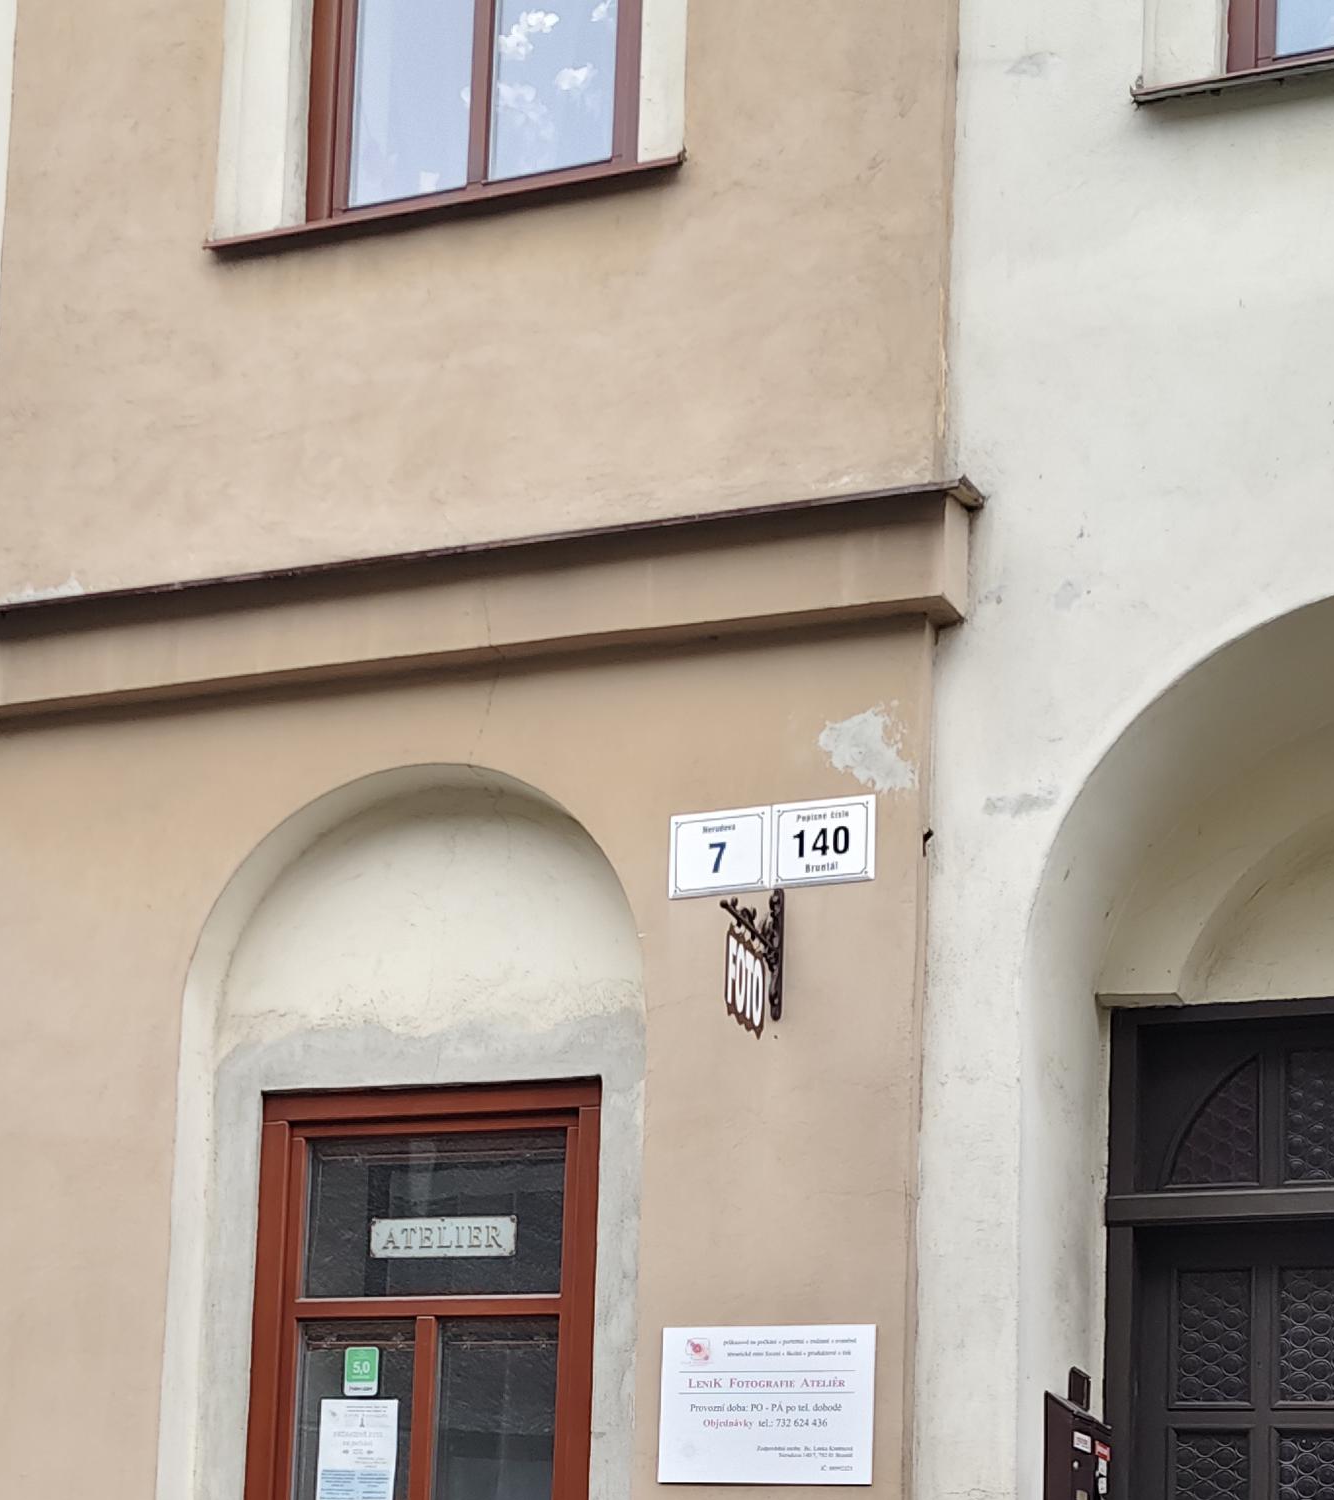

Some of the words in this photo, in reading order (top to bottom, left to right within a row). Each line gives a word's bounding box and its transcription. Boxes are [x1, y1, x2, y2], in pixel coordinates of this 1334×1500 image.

[793, 825, 850, 858] 140
[709, 841, 727, 873] 7
[805, 861, 838, 873] Bruntál
[727, 935, 763, 1027] FOTO
[382, 1226, 503, 1250] ATELIER
[352, 1361, 371, 1376] 5,0
[729, 1378, 795, 1388] FOTOGRAFIE
[690, 1403, 725, 1412] Provozní
[727, 1404, 748, 1412] doba:
[750, 1404, 763, 1412] PO
[771, 1402, 783, 1412] PÁ
[785, 1405, 796, 1414] po
[798, 1404, 810, 1412] tel.
[703, 1418, 753, 1429] Objednávky
[776, 1418, 791, 1427] 732
[793, 1418, 809, 1427] 624
[812, 1418, 828, 1427] 436
